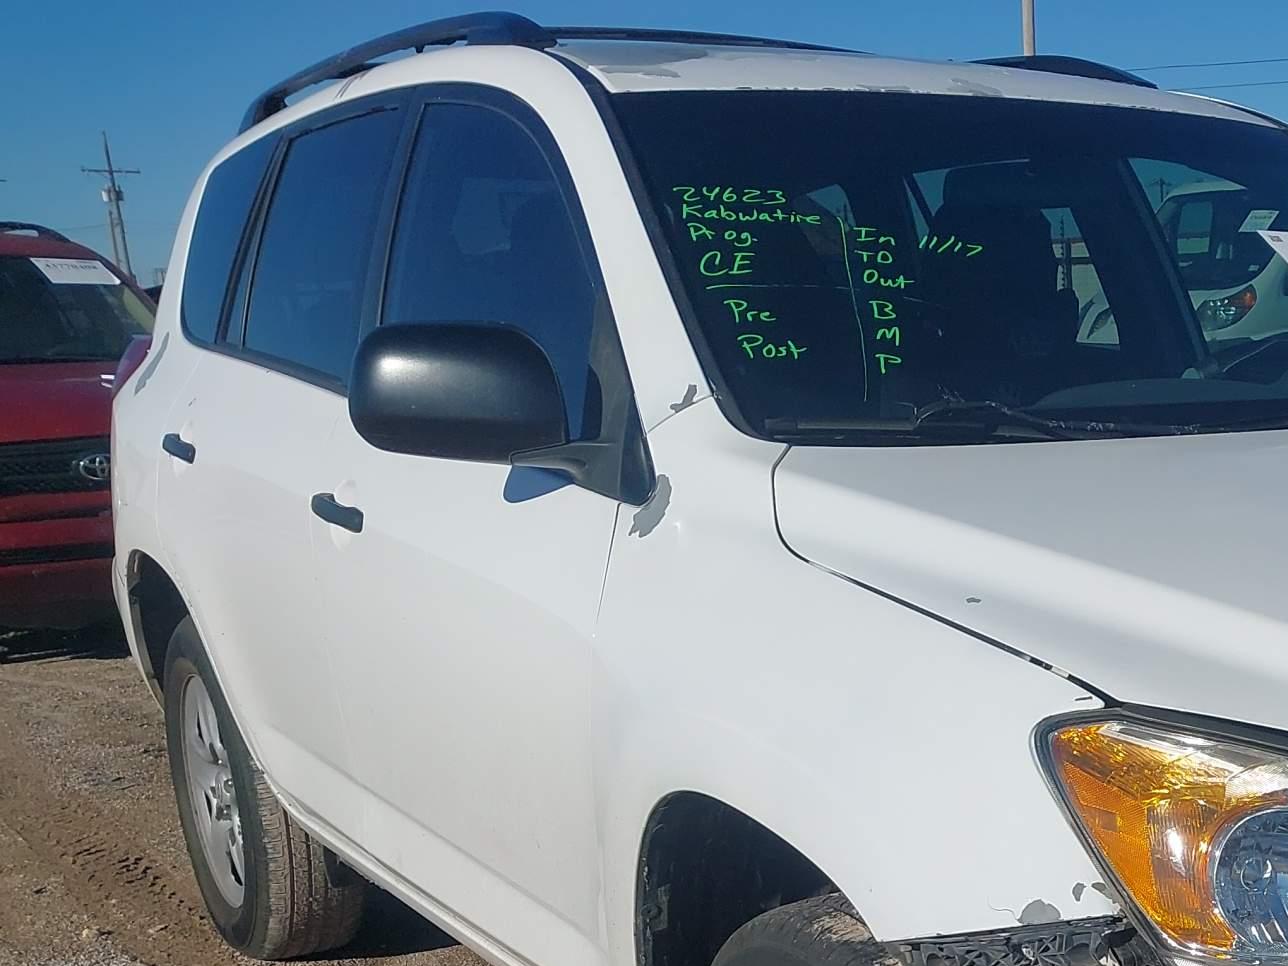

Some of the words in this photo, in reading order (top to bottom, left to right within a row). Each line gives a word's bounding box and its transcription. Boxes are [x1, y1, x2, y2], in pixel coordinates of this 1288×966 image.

[673, 187, 786, 205] 24623
[919, 235, 983, 256] 11/17
[699, 251, 755, 277] CE
[868, 300, 897, 320] B
[876, 326, 900, 346] M
[874, 353, 902, 375] P
